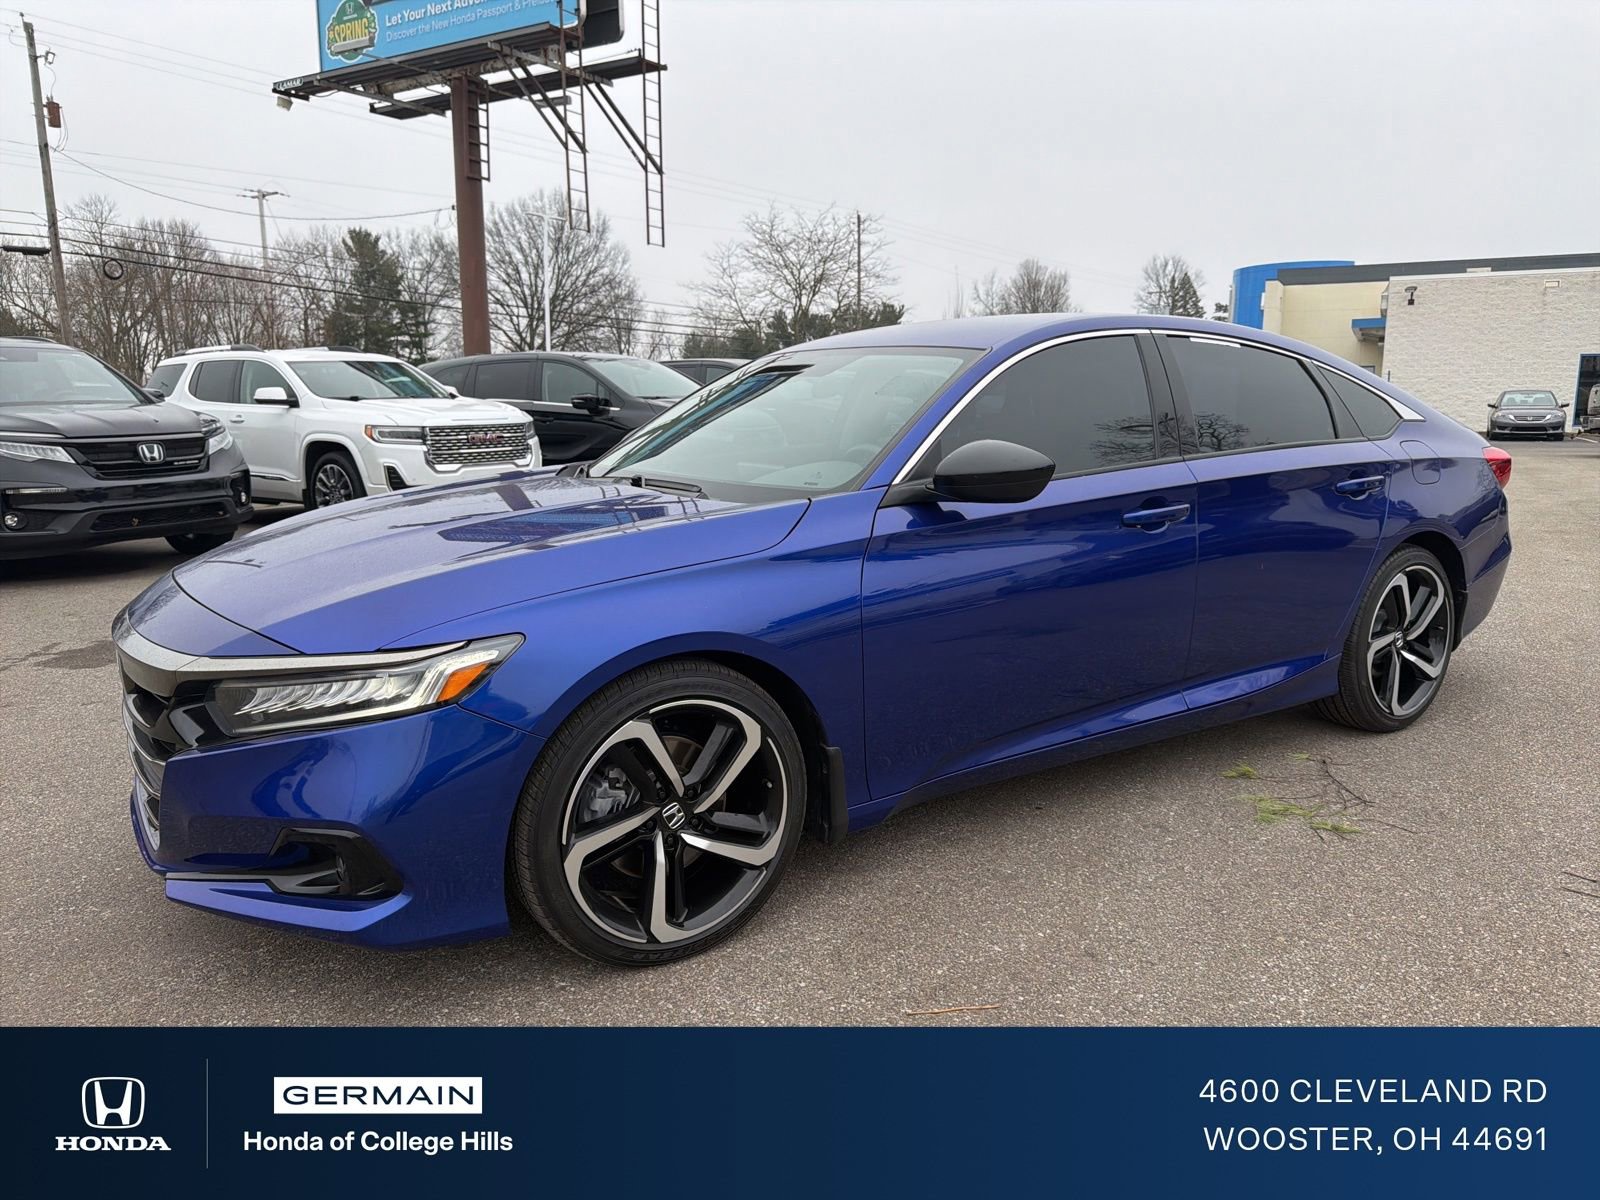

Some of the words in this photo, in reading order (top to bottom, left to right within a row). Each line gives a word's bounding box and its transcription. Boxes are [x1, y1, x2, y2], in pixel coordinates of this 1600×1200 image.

[385, 13, 402, 27] Let
[402, 7, 426, 22] Your
[426, 1, 452, 17] Next
[385, 26, 417, 42] Discover
[418, 21, 431, 33] the
[431, 19, 449, 31] New
[449, 12, 475, 26] Honda
[476, 5, 513, 20] Passport
[513, 0, 522, 11] &
[334, 18, 369, 43] SPRING
[467, 432, 504, 444] GMC
